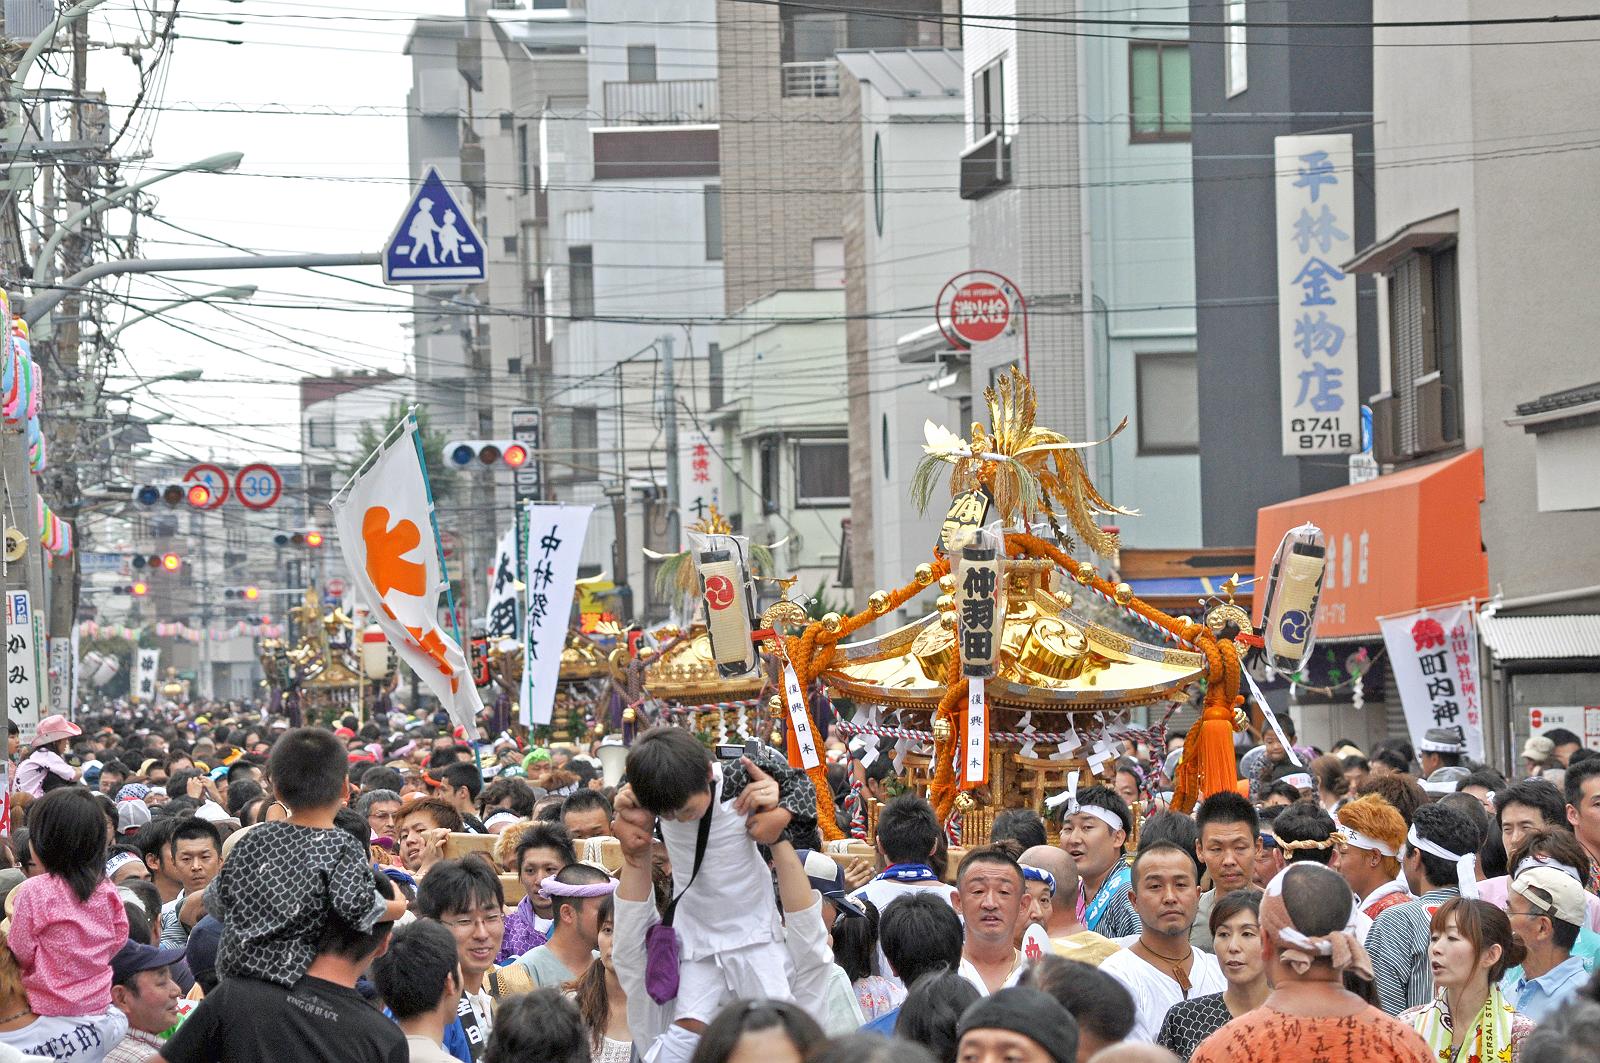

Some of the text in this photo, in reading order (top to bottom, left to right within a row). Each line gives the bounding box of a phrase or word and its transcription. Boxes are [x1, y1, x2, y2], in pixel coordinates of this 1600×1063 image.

[1290, 150, 1350, 413] 平林金物店
[955, 298, 1006, 325] 消火栓
[1299, 434, 1352, 449] 9718
[1310, 418, 1340, 432] 741
[245, 476, 271, 497] 30
[963, 567, 997, 662] 仲羽田
[1412, 618, 1445, 652] 祭
[8, 634, 30, 714] かみや
[789, 684, 814, 754] 復興日本
[969, 694, 983, 769] 復興日本
[287, 995, 305, 1010] KING
[314, 1006, 339, 1022] BLACK
[1485, 994, 1494, 1062] VERSAL STU
